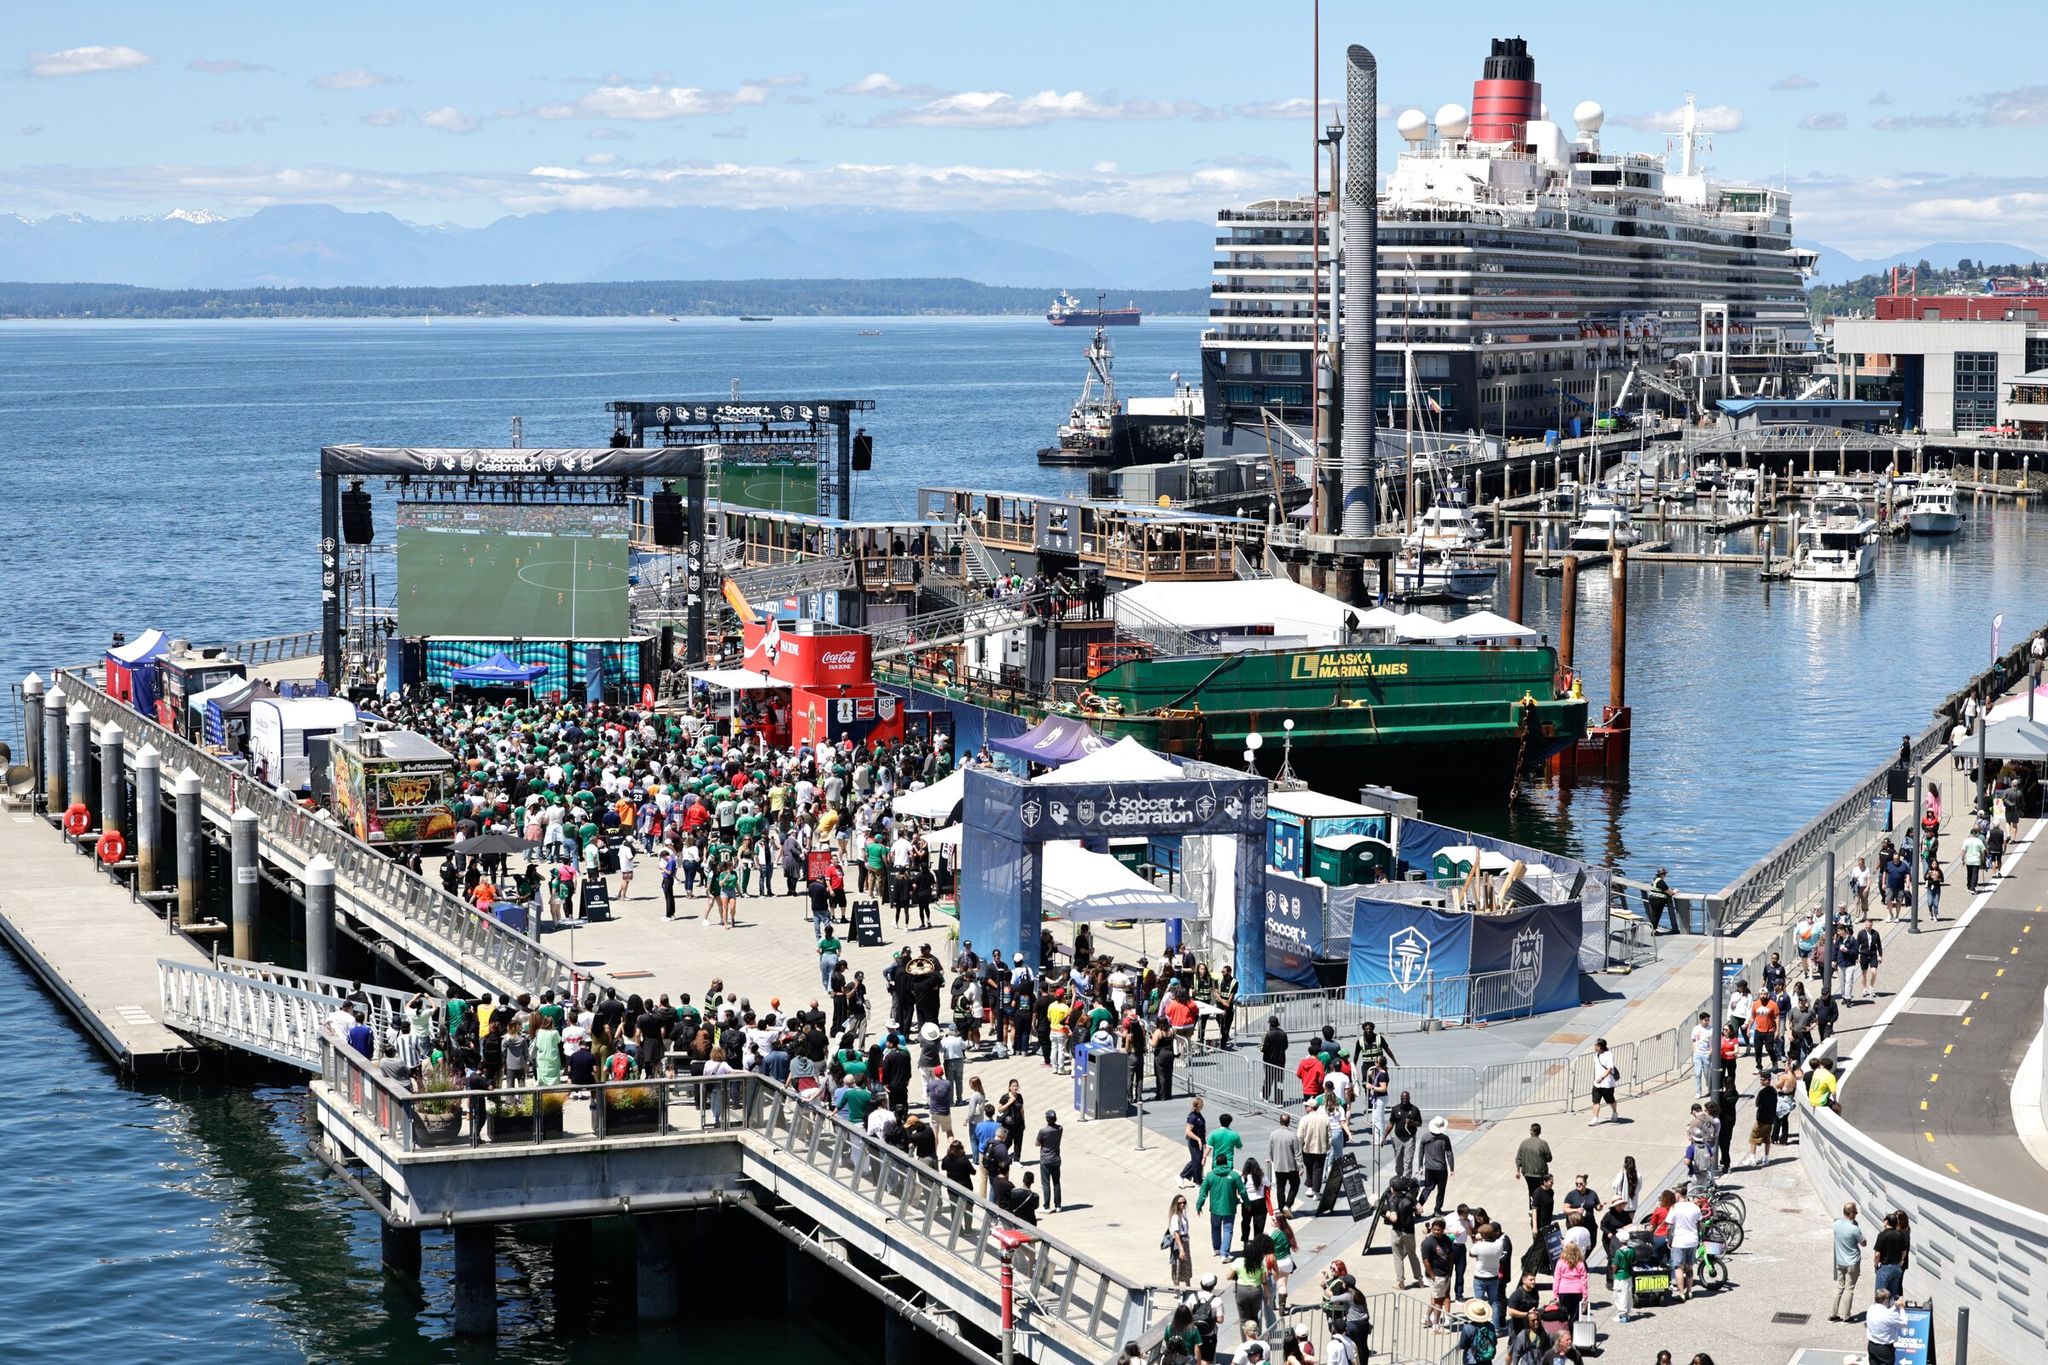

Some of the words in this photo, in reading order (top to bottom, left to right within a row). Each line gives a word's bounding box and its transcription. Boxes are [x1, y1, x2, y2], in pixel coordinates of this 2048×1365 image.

[725, 405, 762, 415] Soccer
[712, 413, 776, 423] Celebration
[489, 454, 528, 464] Soccer
[475, 461, 541, 473] Celebration
[822, 650, 857, 665] Coca-Cola
[1320, 653, 1372, 666] ALASKA
[1319, 665, 1369, 678] MARINE
[1371, 663, 1408, 676] LINES
[880, 700, 894, 708] USA
[633, 794, 643, 802] 23
[1119, 797, 1173, 811] Soccer
[1100, 808, 1193, 826] Celebration
[720, 851, 731, 863] 10
[1267, 917, 1300, 939] Soccer
[1265, 931, 1313, 957] elebration
